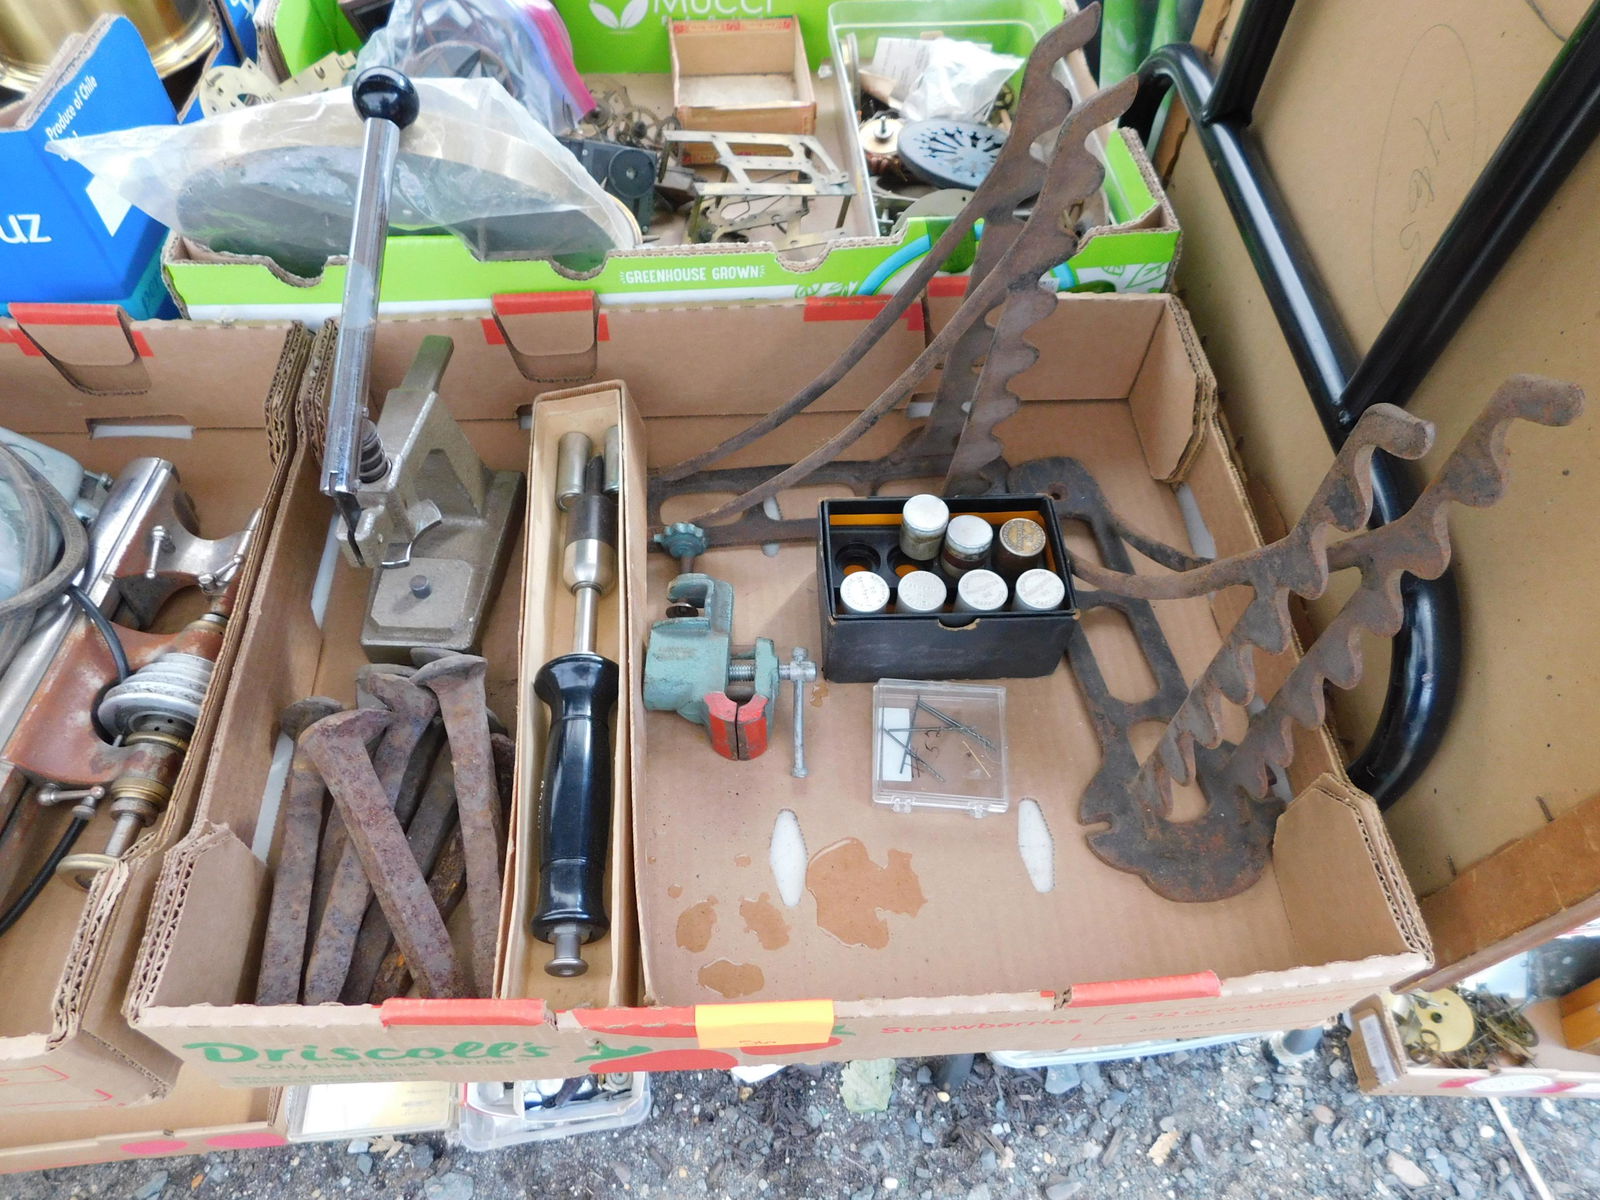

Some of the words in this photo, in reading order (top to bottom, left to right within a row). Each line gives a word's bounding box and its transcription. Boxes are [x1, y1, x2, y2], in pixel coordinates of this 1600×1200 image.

[45, 105, 76, 142] Produce
[74, 89, 84, 110] of
[79, 75, 98, 100] Chile
[625, 267, 706, 284] GREENHOUSE
[711, 265, 759, 281] GROWN
[881, 1018, 1082, 1034] Strawberries
[182, 1041, 556, 1064] Driscoll's
